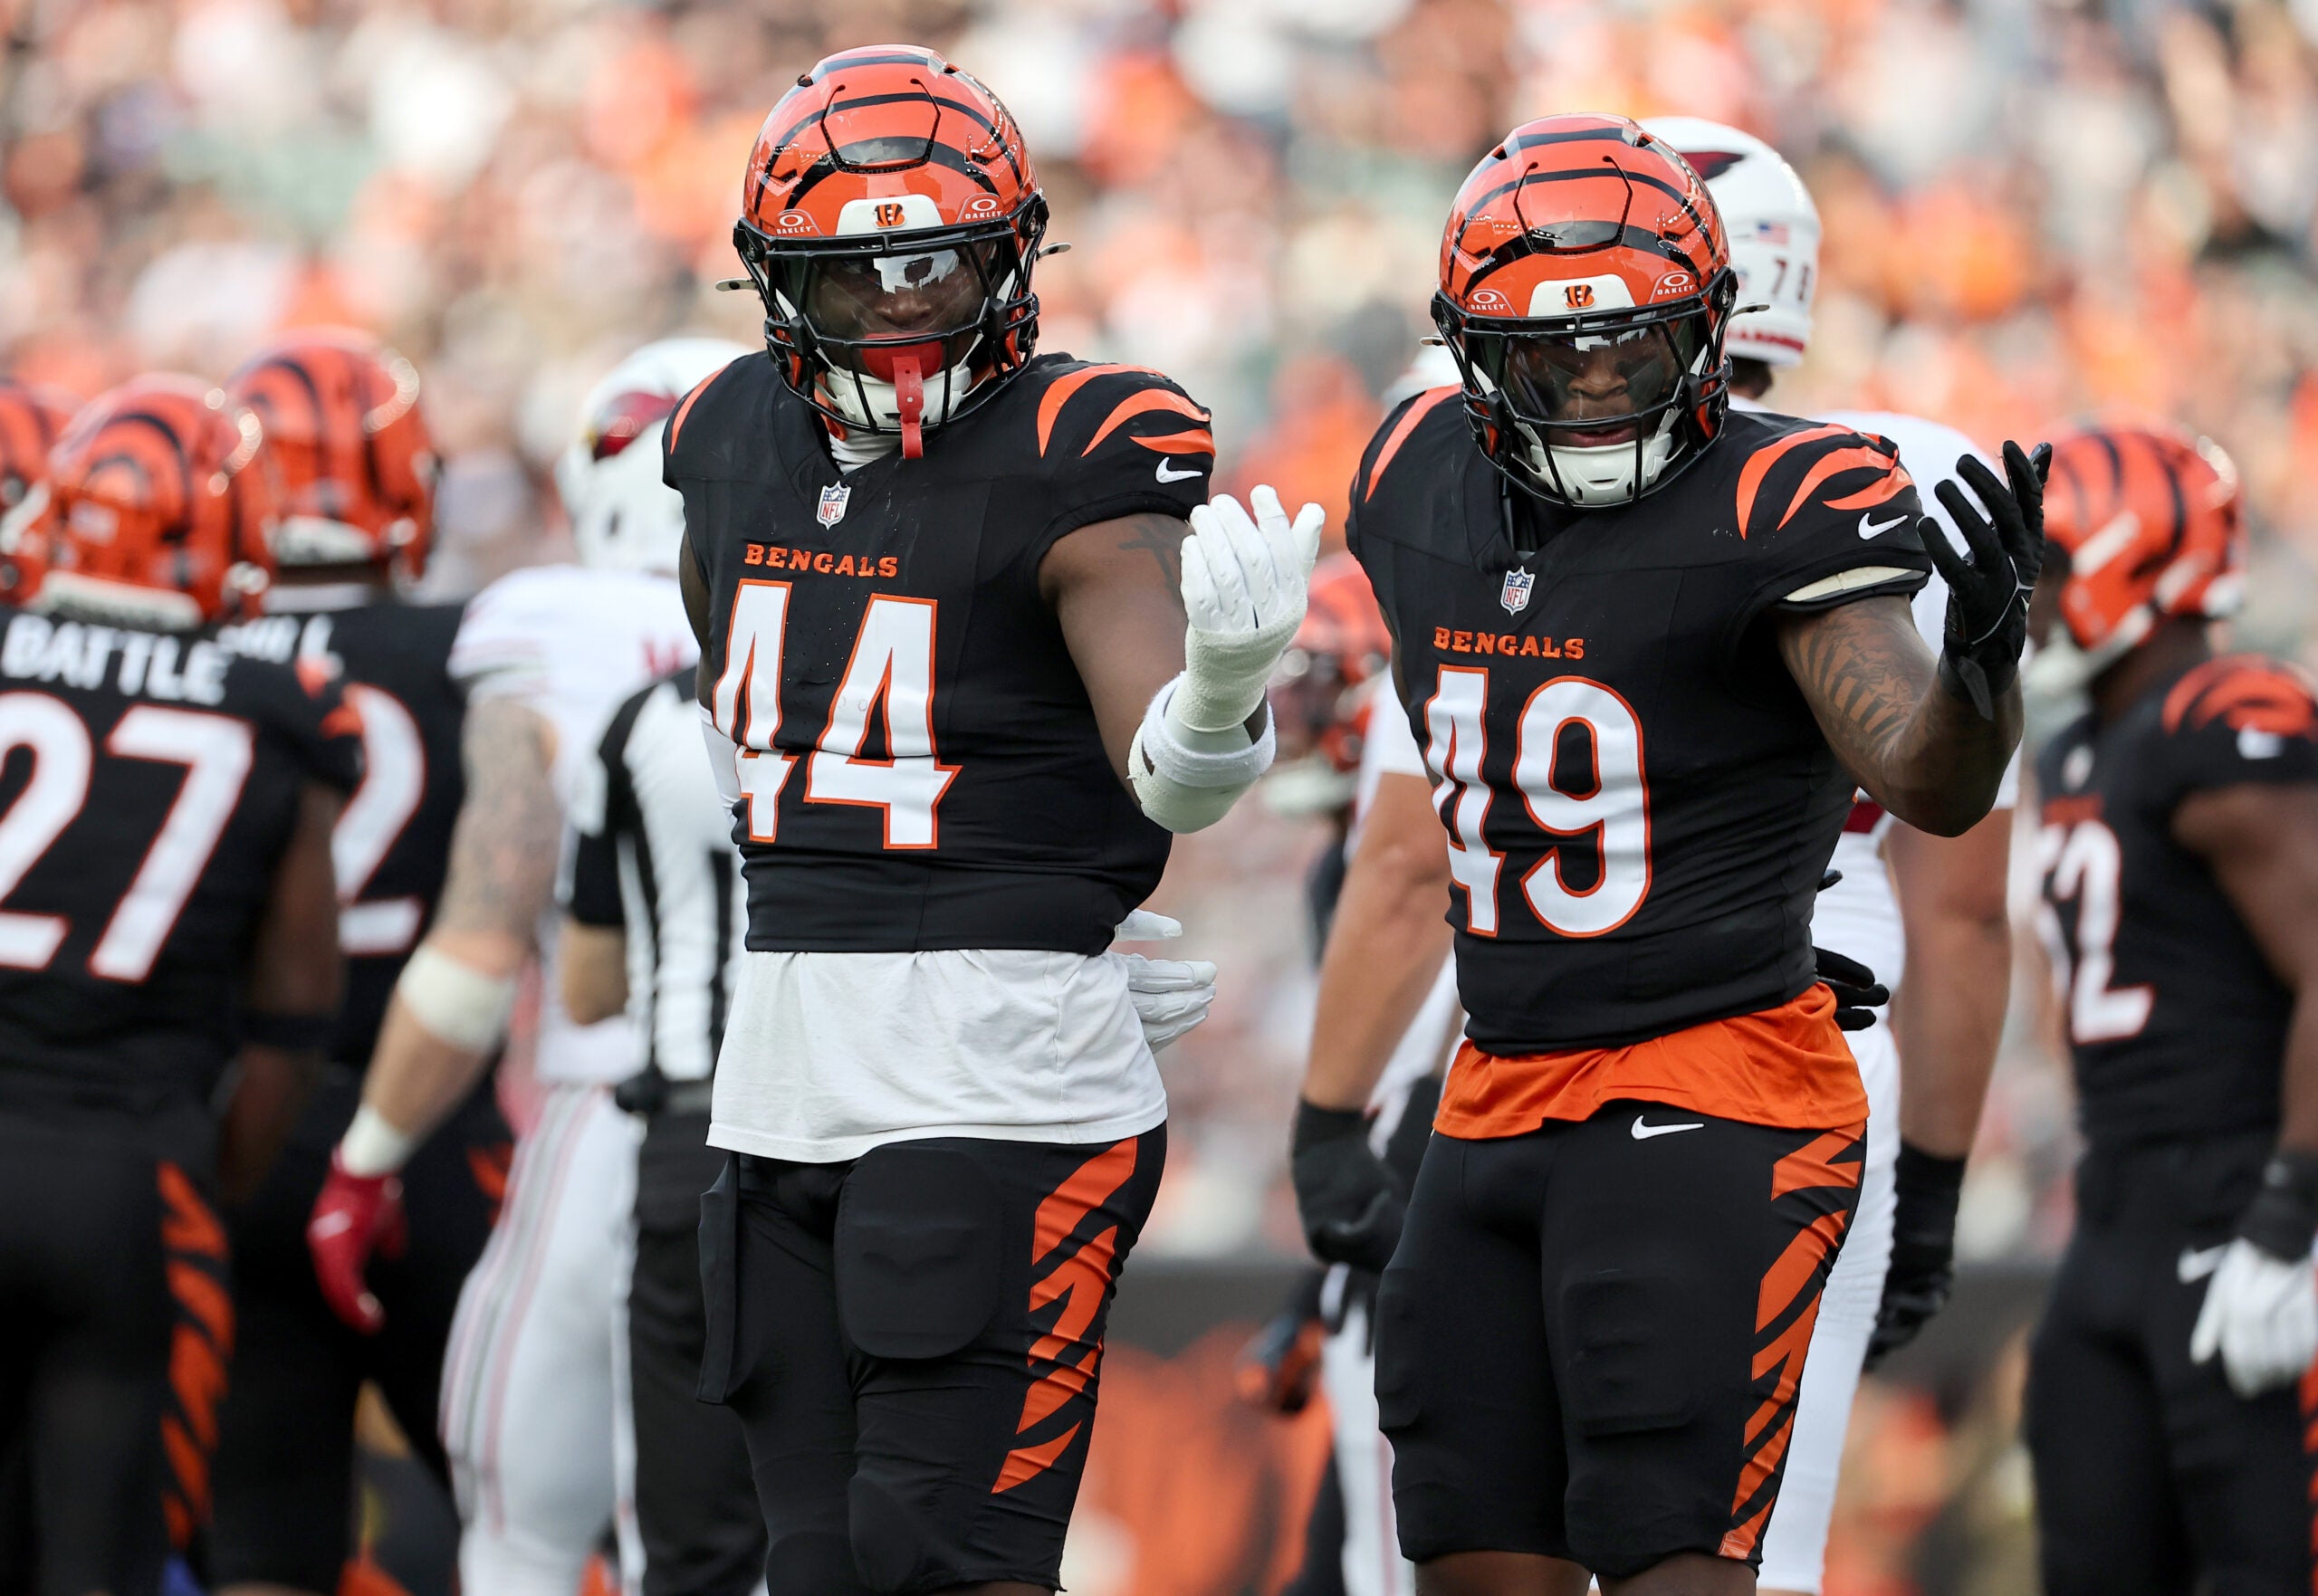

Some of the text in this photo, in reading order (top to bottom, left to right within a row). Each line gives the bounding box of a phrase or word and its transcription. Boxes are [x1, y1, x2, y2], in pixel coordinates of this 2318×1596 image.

[965, 210, 1003, 220] OAKLEY
[776, 225, 812, 235] OAKLEY
[1656, 285, 1694, 296] OAKLEY
[1470, 303, 1506, 311] OAKLEY
[821, 502, 840, 520] NFL
[743, 542, 899, 578] BENGALS
[1505, 588, 1524, 606] NFL
[1432, 626, 1585, 660] BENGALS
[2, 614, 234, 706] BATTLE
[713, 578, 963, 850] 44
[1423, 664, 1652, 938] 49
[0, 690, 255, 985] 27
